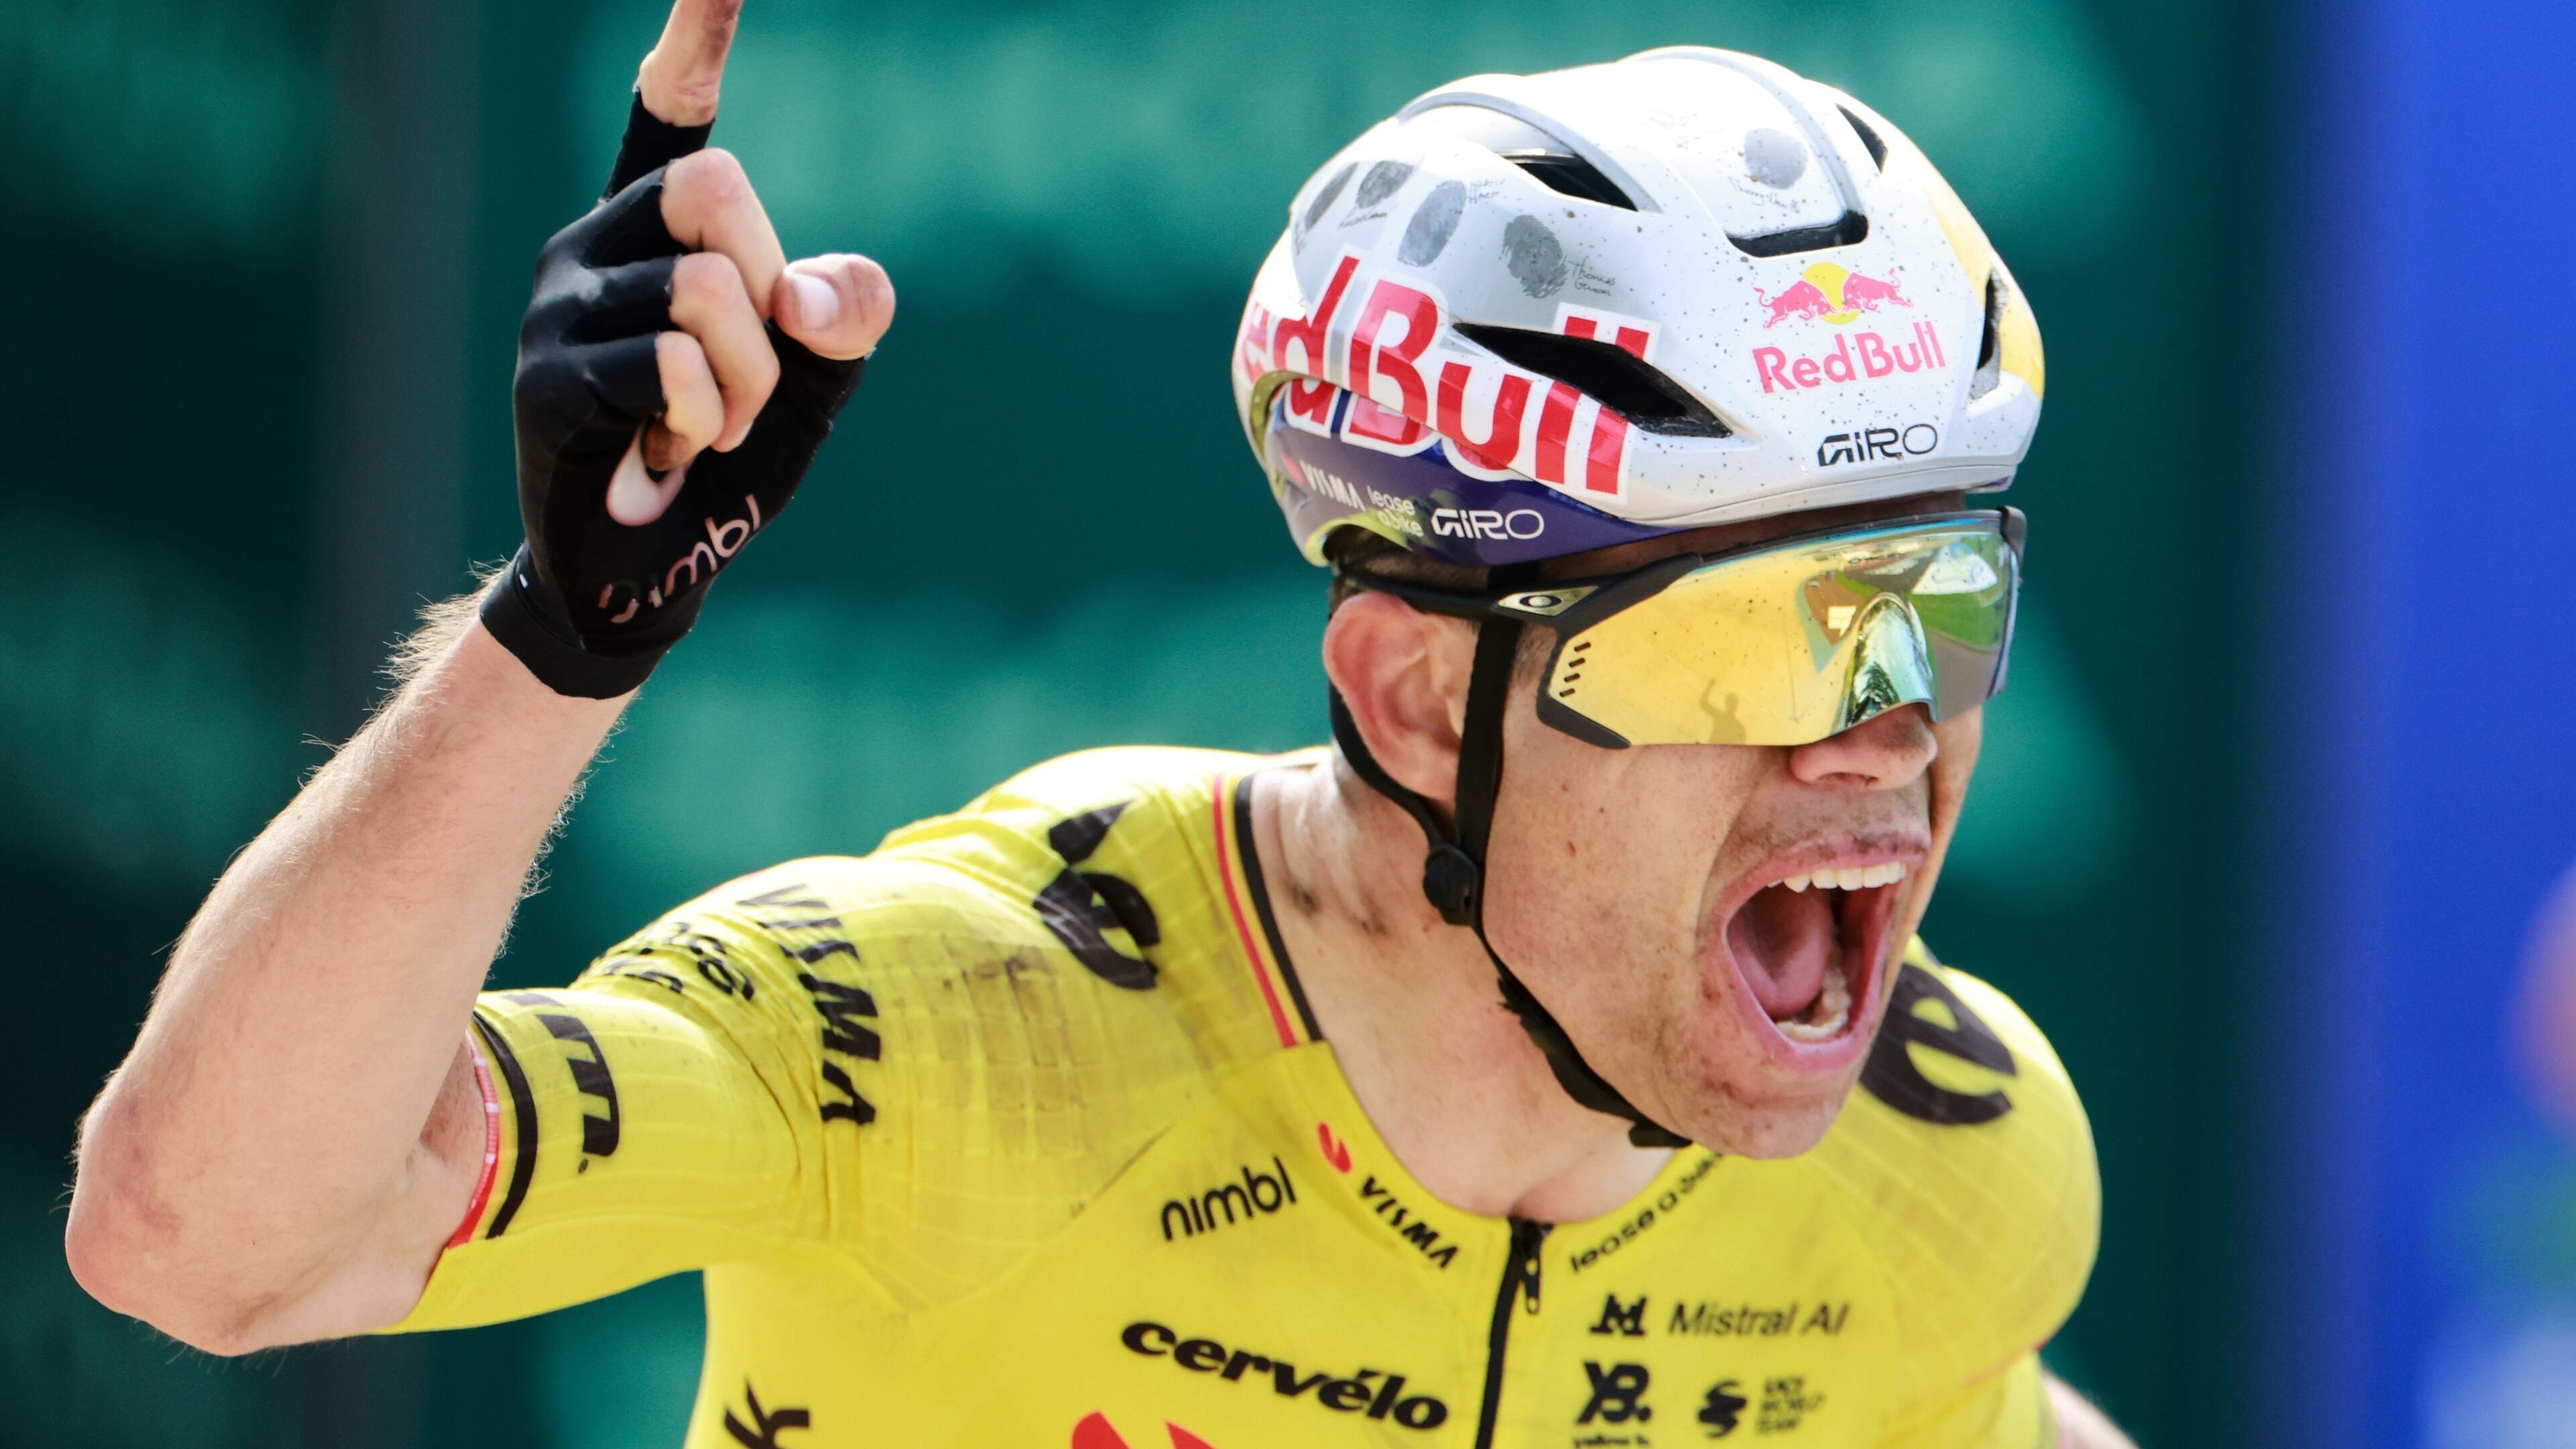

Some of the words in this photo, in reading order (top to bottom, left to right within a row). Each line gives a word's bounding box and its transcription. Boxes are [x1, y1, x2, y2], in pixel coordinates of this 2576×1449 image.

[1752, 333, 1858, 394] Red
[1854, 320, 1947, 380] Bull
[1817, 423, 1939, 466] GIRO
[1299, 460, 1366, 513] VISMA
[1366, 485, 1416, 516] lease
[1430, 507, 1544, 540] GIRO
[734, 883, 881, 1126] VISMA
[1160, 1155, 1297, 1242] nimbl
[1358, 1175, 1460, 1270] VISMA
[1667, 1301, 1799, 1336] Mistral
[1801, 1301, 1853, 1336] AI
[1120, 1321, 1448, 1431] cervélo
